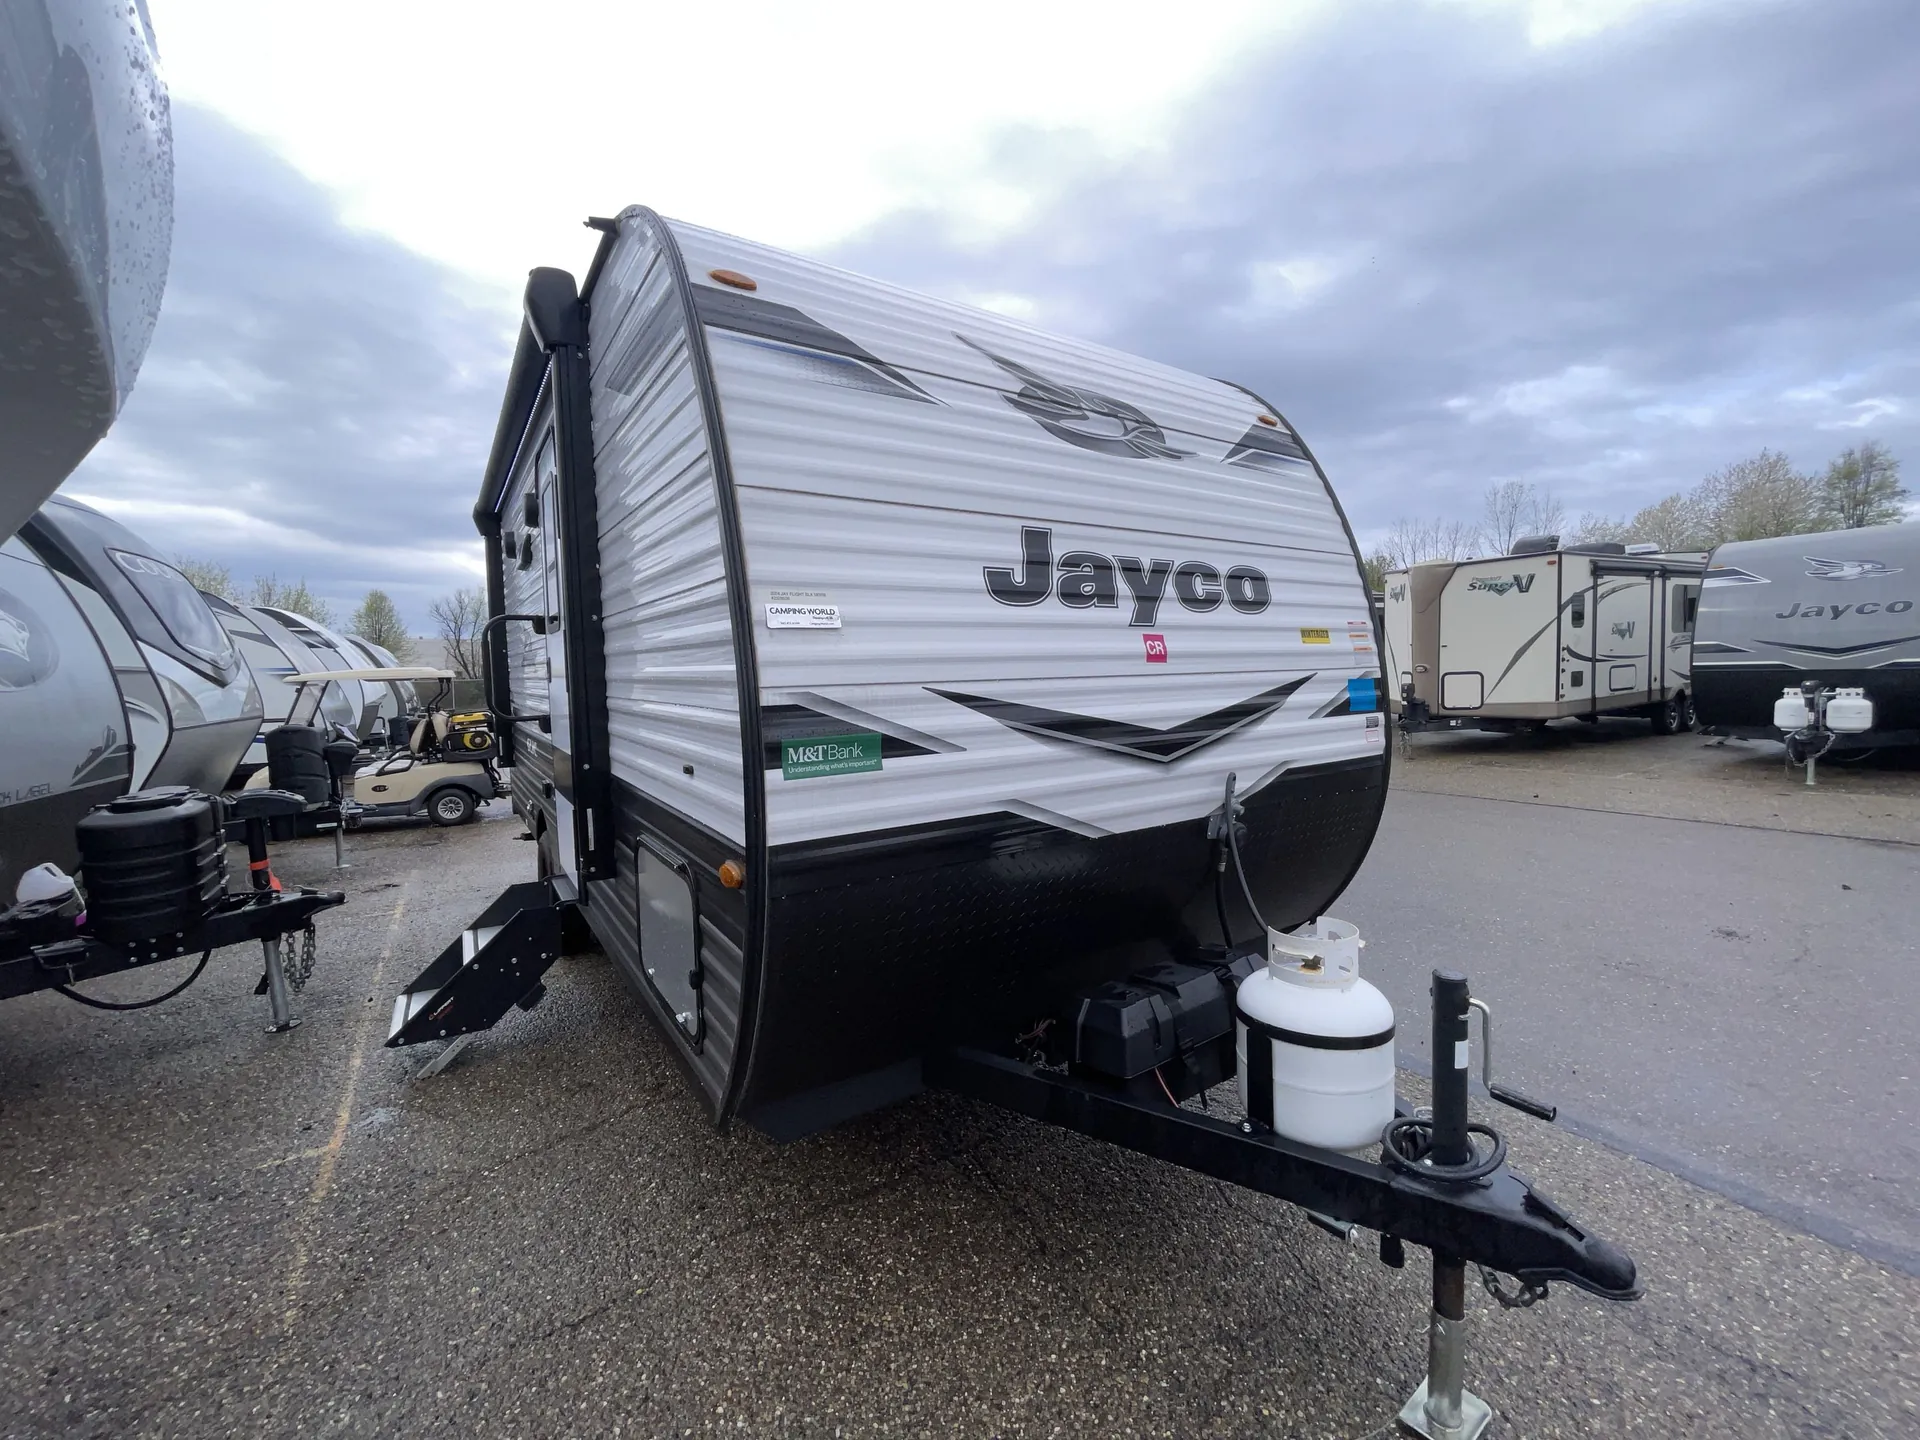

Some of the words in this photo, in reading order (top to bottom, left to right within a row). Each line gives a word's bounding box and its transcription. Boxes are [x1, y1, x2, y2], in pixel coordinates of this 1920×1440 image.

[982, 525, 1272, 627] Jayco
[769, 607, 806, 615] CAMPING
[1775, 599, 1914, 621] Jayco
[1146, 640, 1165, 656] CR
[787, 745, 827, 763] M&T
[828, 742, 863, 760] Bank
[788, 764, 830, 774] Understanding
